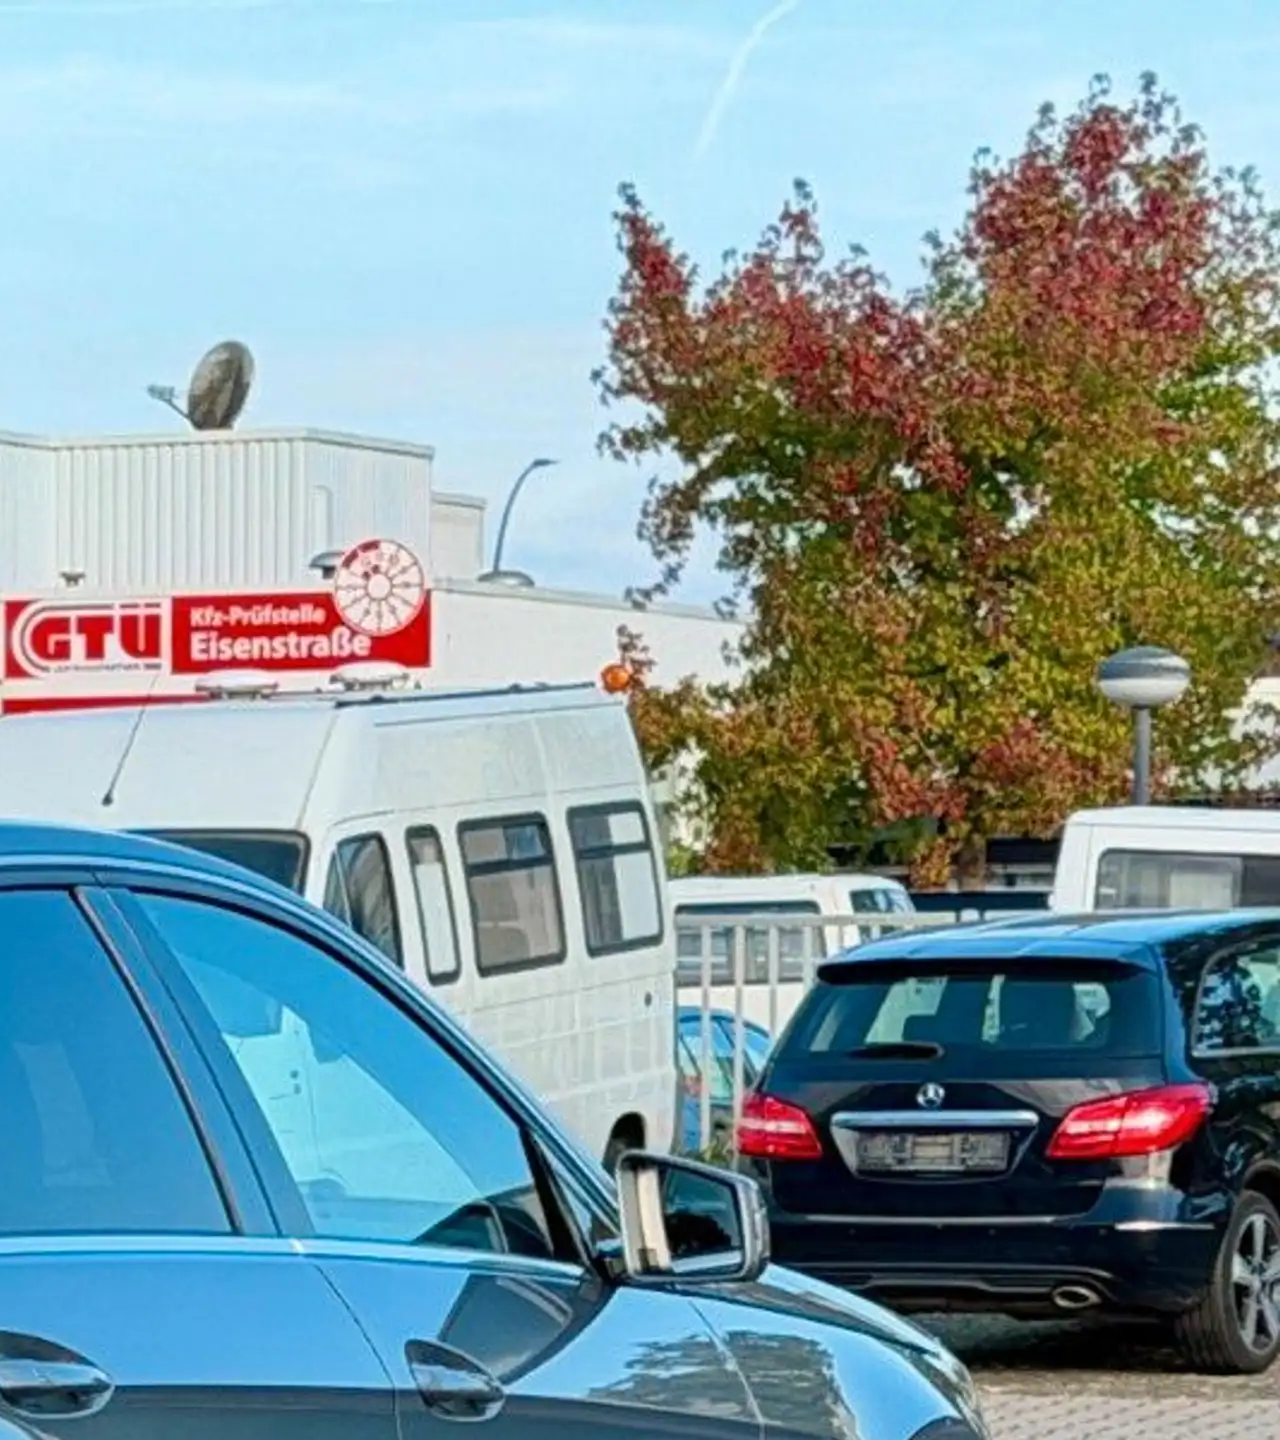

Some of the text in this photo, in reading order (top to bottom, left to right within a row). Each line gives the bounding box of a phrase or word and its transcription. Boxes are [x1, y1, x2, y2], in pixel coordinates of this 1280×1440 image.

[29, 603, 163, 661] GTÜ
[190, 605, 327, 627] Kfz-Prüfstelle
[190, 626, 372, 661] Eisenstraße
